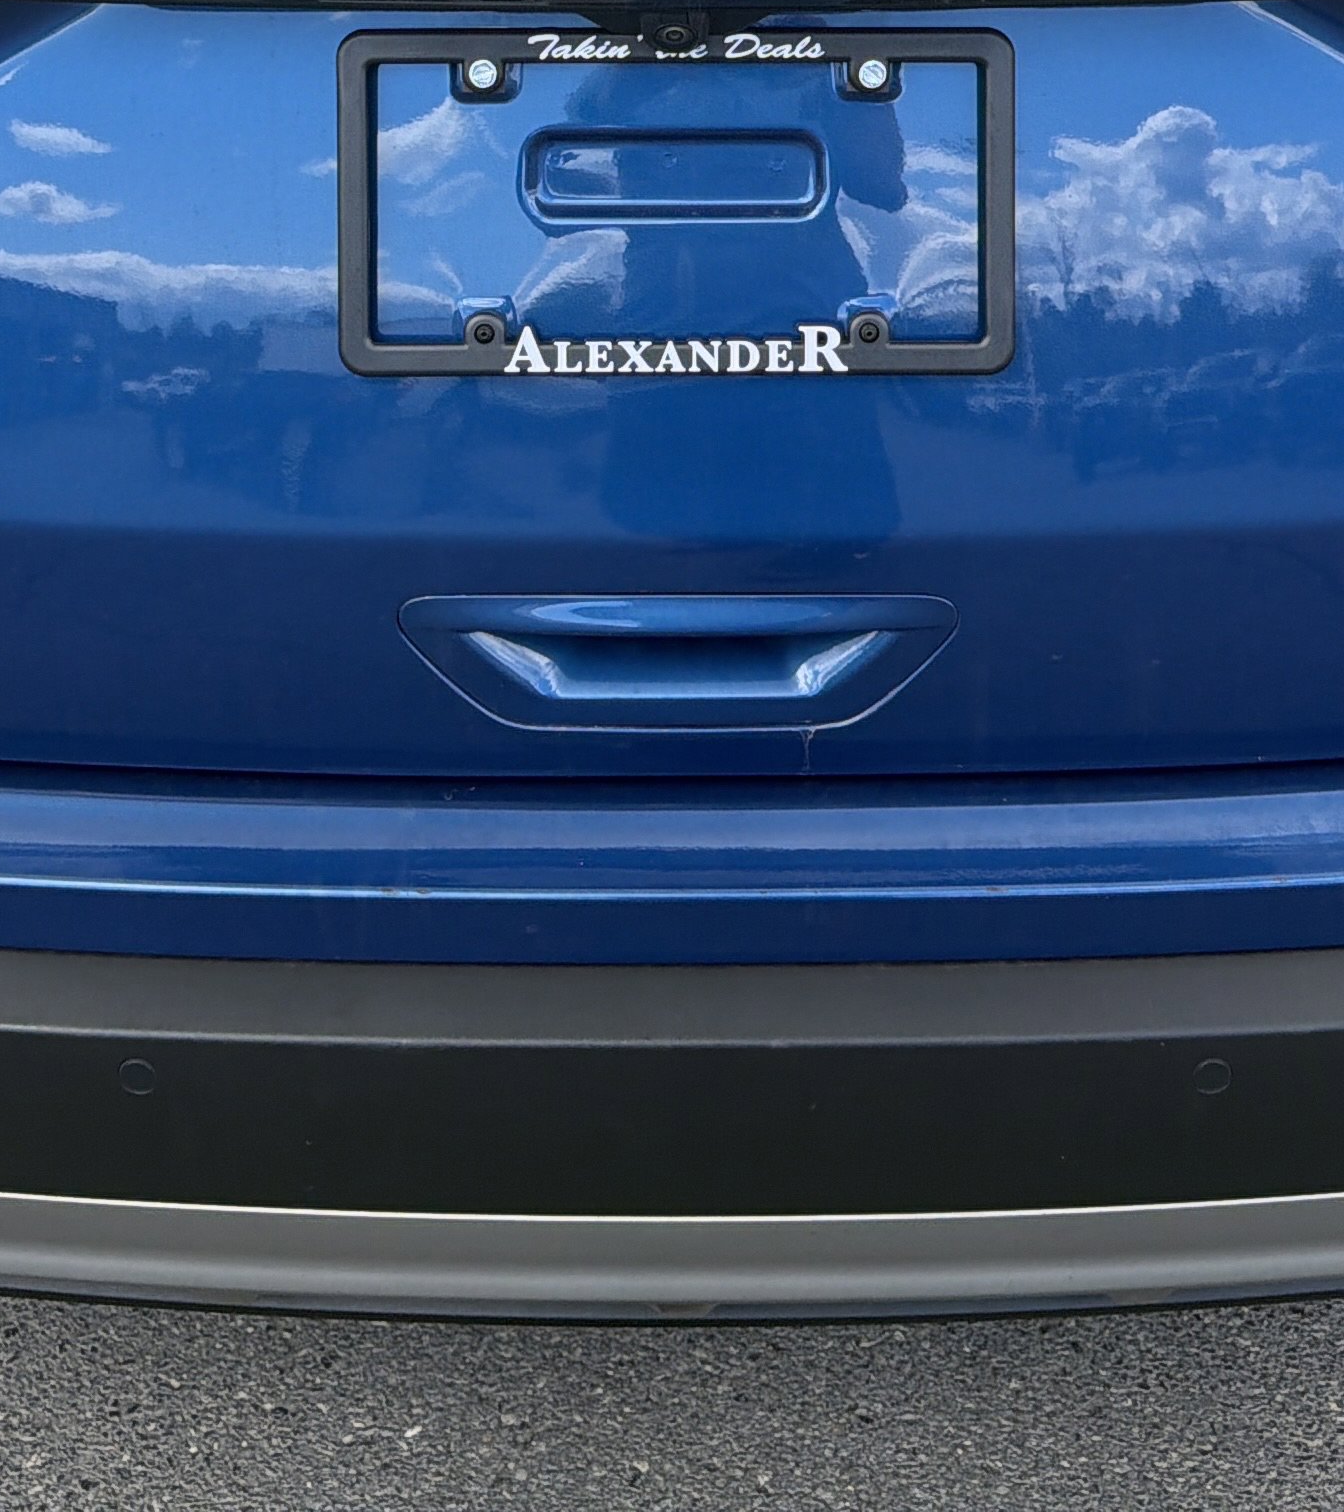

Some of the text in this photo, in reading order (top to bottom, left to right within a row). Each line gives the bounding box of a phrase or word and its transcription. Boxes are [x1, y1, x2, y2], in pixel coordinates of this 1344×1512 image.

[527, 33, 644, 61] Takin'
[723, 32, 826, 60] Deals
[503, 323, 849, 375] ALEXANDER
